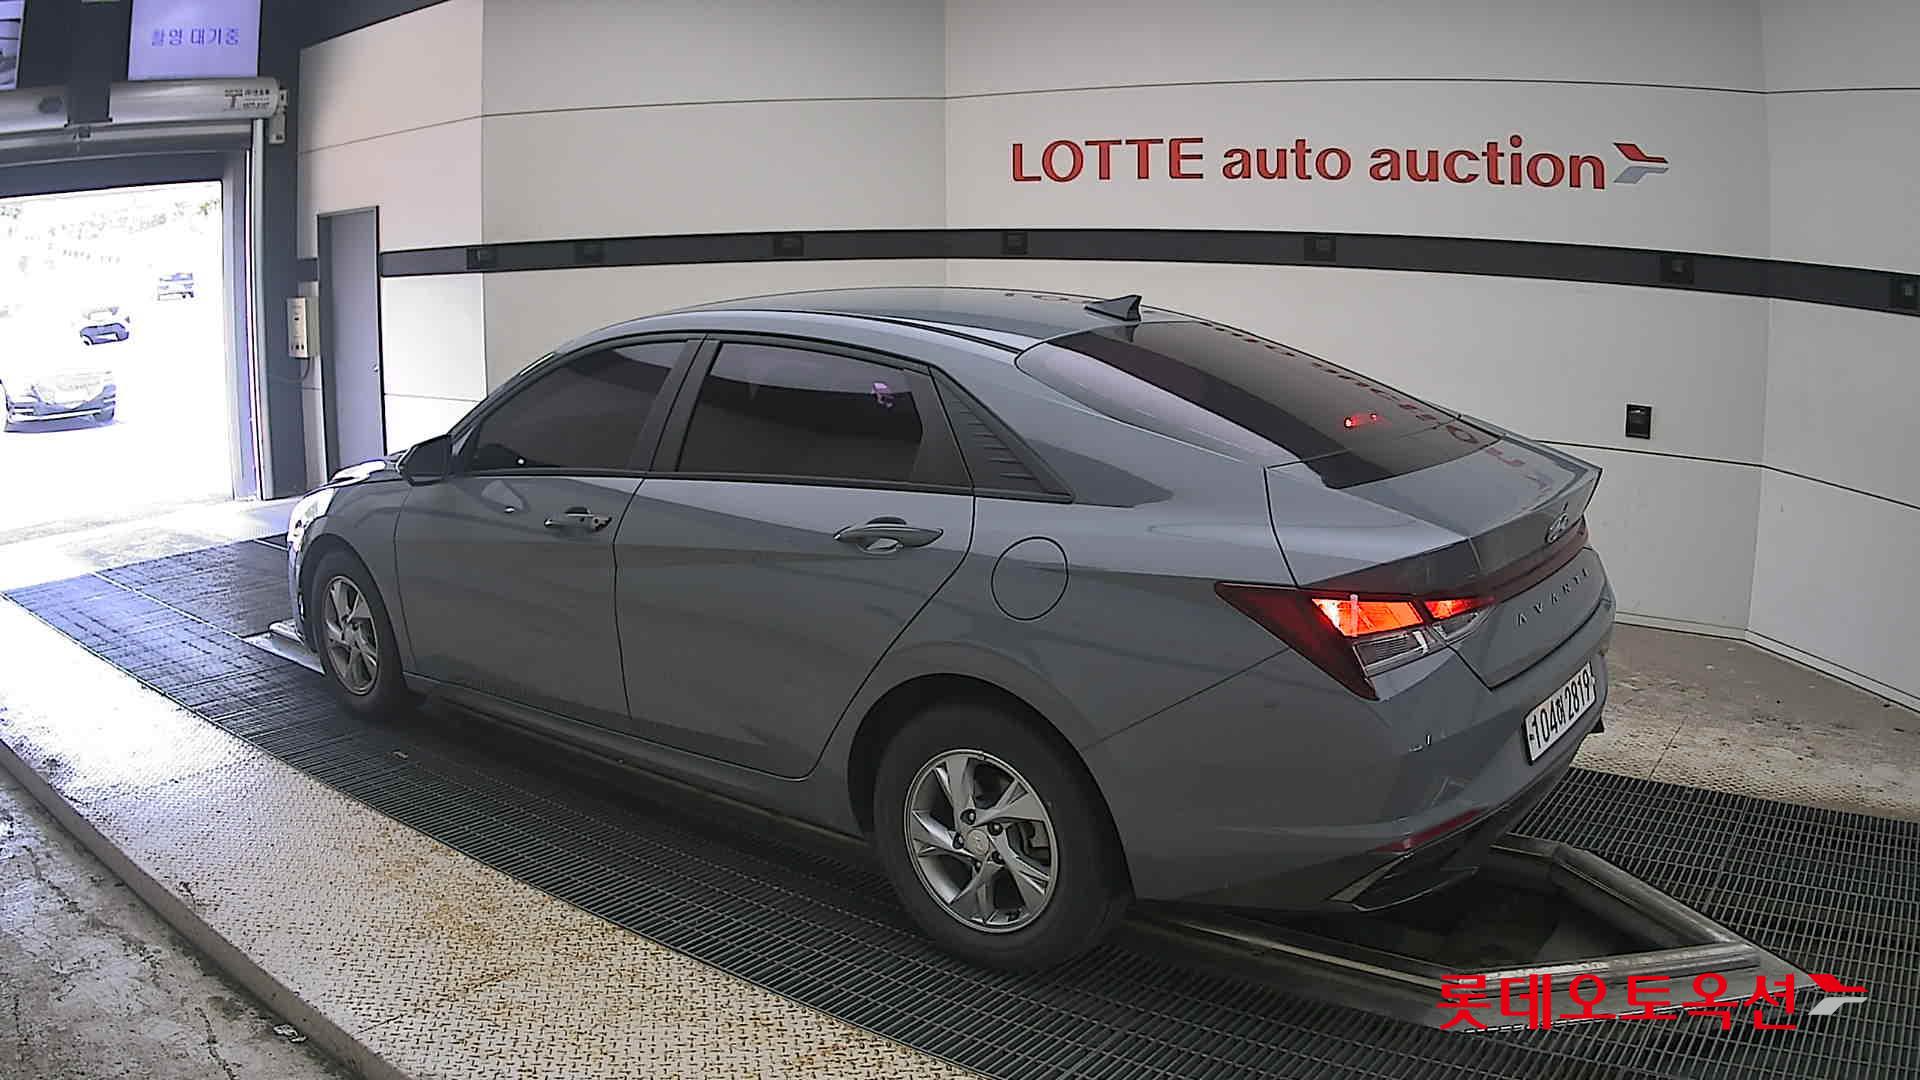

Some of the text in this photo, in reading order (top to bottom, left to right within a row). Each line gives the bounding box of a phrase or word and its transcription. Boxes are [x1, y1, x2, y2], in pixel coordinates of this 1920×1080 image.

[190, 28, 241, 46] 대기중
[1011, 135, 1606, 190] LOTTE auto auction
[1564, 668, 1591, 721] 2819
